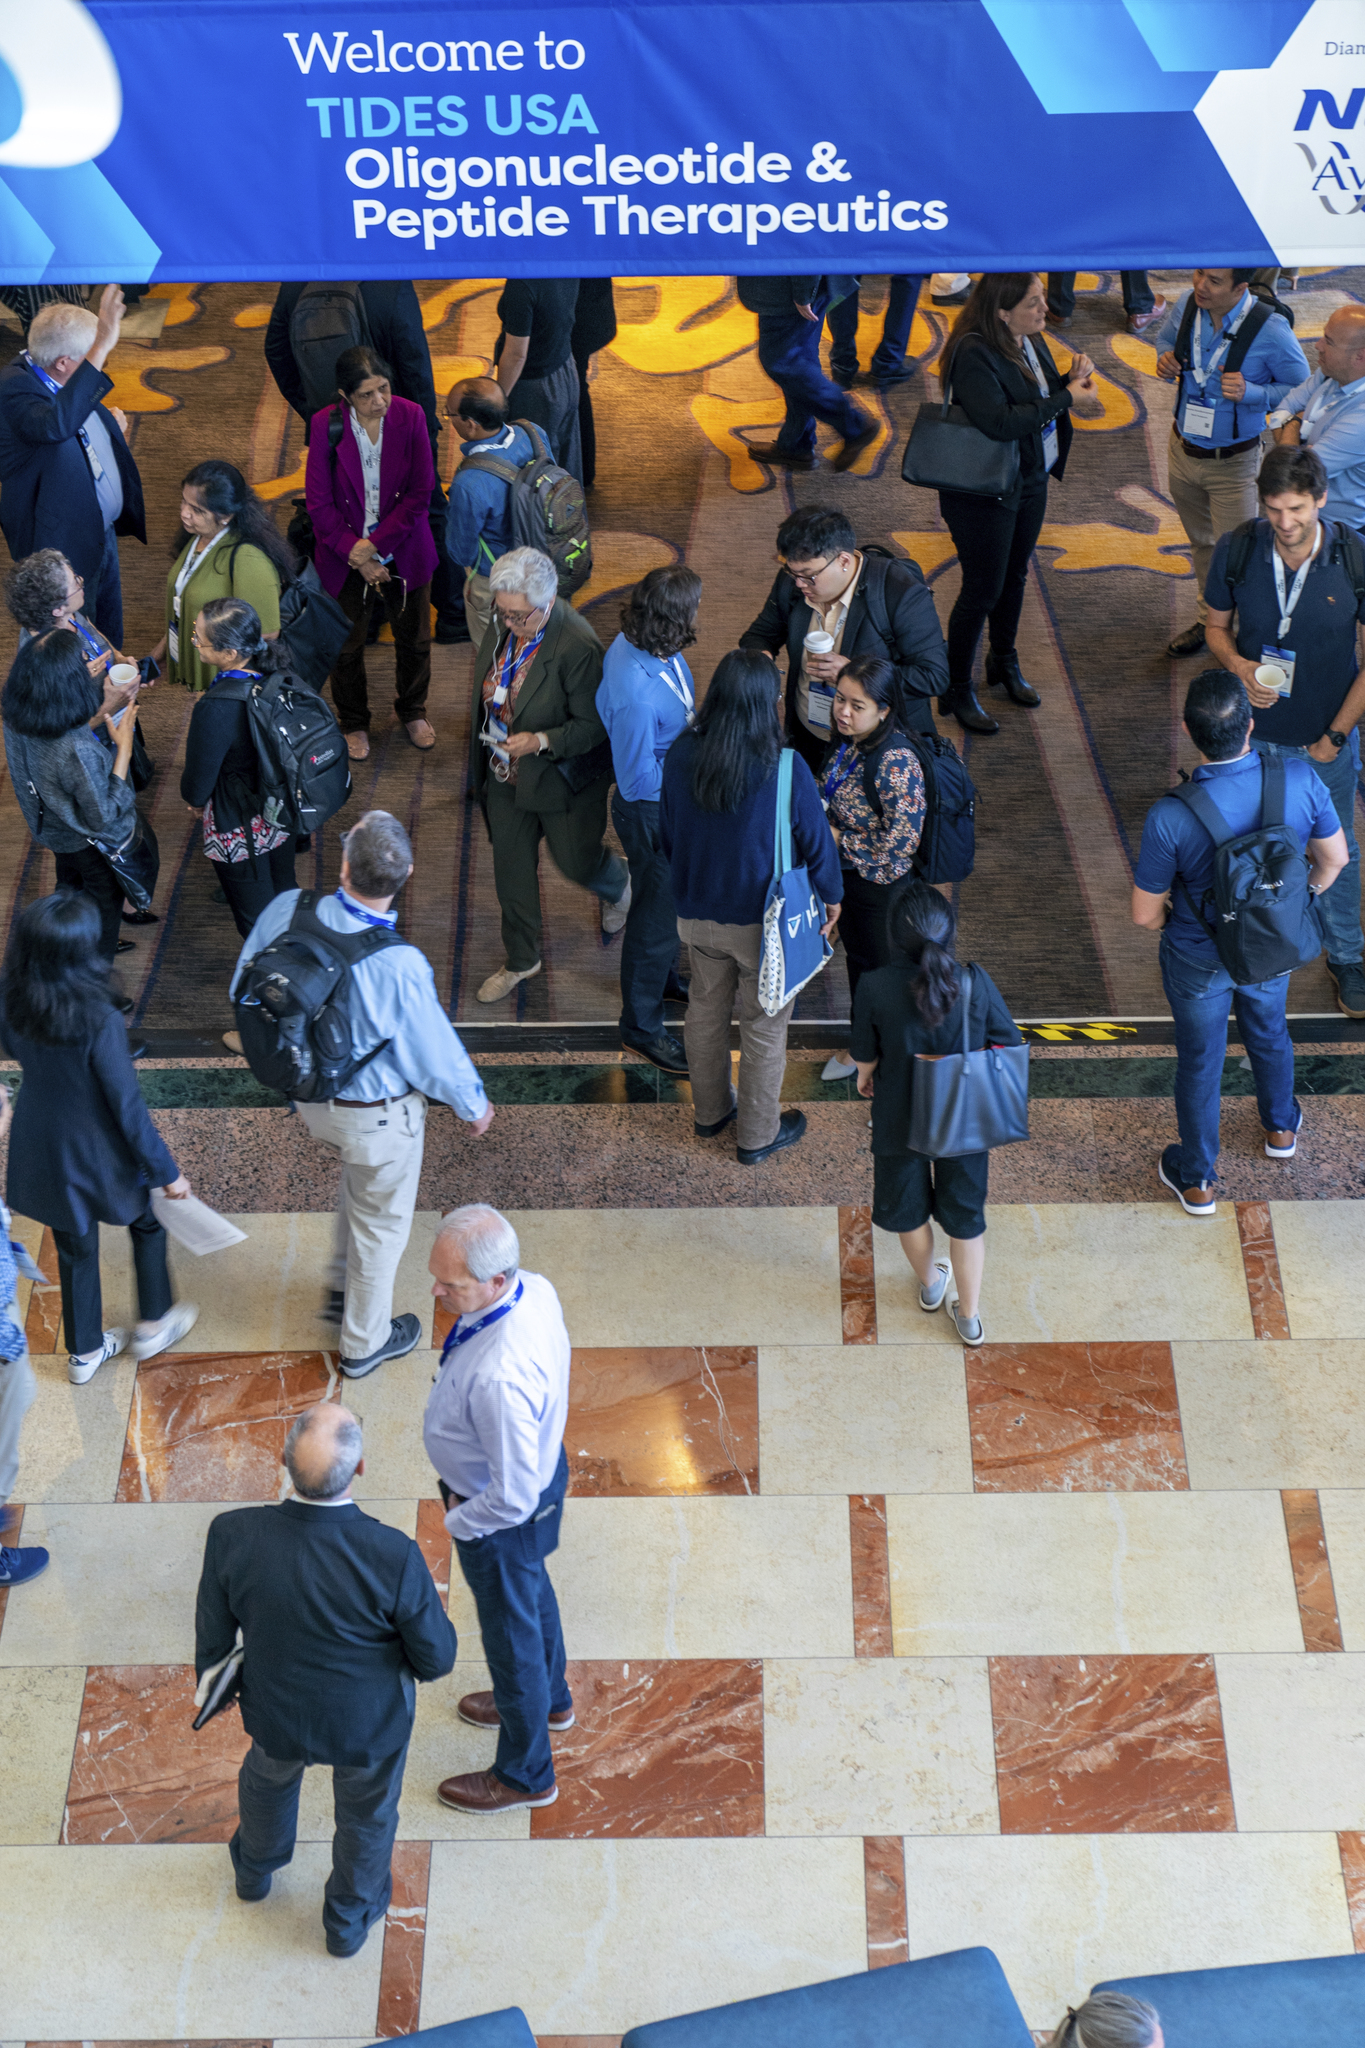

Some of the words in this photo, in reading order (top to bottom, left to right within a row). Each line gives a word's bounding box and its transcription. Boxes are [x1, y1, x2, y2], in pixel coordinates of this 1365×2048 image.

[283, 30, 524, 74] Welcome
[533, 31, 586, 71] to
[305, 95, 469, 138] TIDES
[484, 94, 600, 136] USA
[345, 142, 792, 200] Oligonucleotide
[805, 141, 853, 183] &
[352, 196, 570, 250] Peptide
[582, 190, 949, 245] Therapeutics
